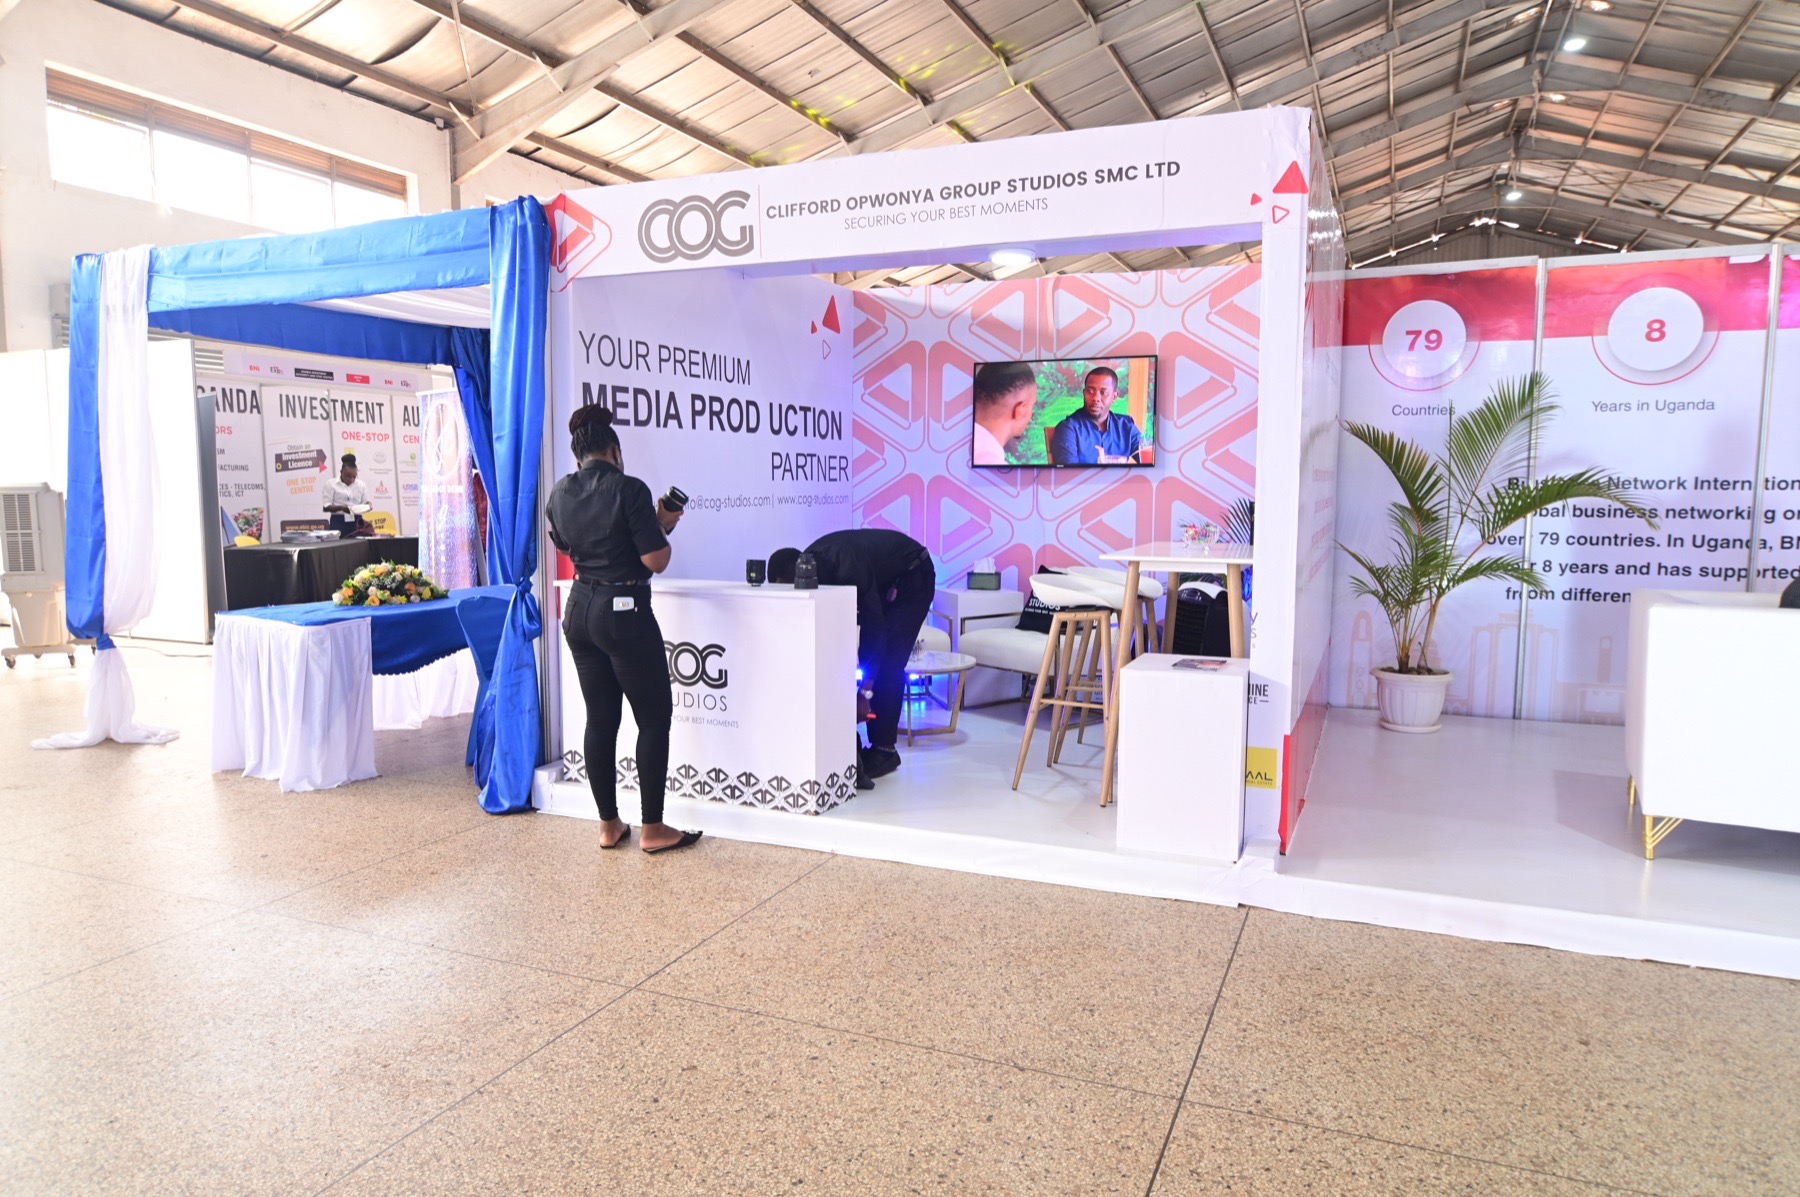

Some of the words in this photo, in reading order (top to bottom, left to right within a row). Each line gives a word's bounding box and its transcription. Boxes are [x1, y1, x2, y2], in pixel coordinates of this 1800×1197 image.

[766, 199, 841, 219] CLIFFORD
[846, 188, 935, 211] OPWONYA
[939, 180, 1001, 200] GROUP
[1007, 171, 1088, 193] STUDIOS
[1094, 165, 1138, 184] SMC
[1145, 161, 1181, 179] LTD
[844, 211, 907, 230] SECURING
[910, 208, 946, 224] YOUR
[949, 204, 977, 220] BEST
[980, 198, 1048, 216] MOMENTS
[638, 190, 754, 263] COG
[1405, 329, 1443, 351] 79
[1645, 319, 1666, 342] 8
[578, 330, 652, 373] YOUR
[658, 344, 751, 386] PREMIUM
[197, 385, 262, 415] ANDA
[279, 393, 384, 425] INVESTMENT
[582, 381, 683, 430] MEDIA
[1391, 404, 1456, 416] Countries
[1592, 400, 1632, 412] Years
[1637, 400, 1649, 411] in
[1655, 399, 1715, 414] Uganda
[341, 431, 390, 443] ONE-STOP
[282, 450, 318, 461] Investment
[288, 460, 313, 469] Licence
[771, 452, 850, 482] PARTNER
[1608, 476, 1688, 490] Network
[1694, 476, 1800, 491] Interntion
[1572, 504, 1659, 519] business
[1665, 506, 1776, 524] networkig
[1539, 532, 1560, 546] 79
[1566, 533, 1661, 547] countries.
[1667, 534, 1684, 548] In
[1542, 560, 1553, 573] 8
[1559, 563, 1609, 577] years
[1615, 562, 1650, 576] and
[1657, 562, 1692, 576] has
[672, 714, 691, 722] YOUR
[691, 715, 705, 725] BEST
[706, 718, 740, 729] MOMENTS
